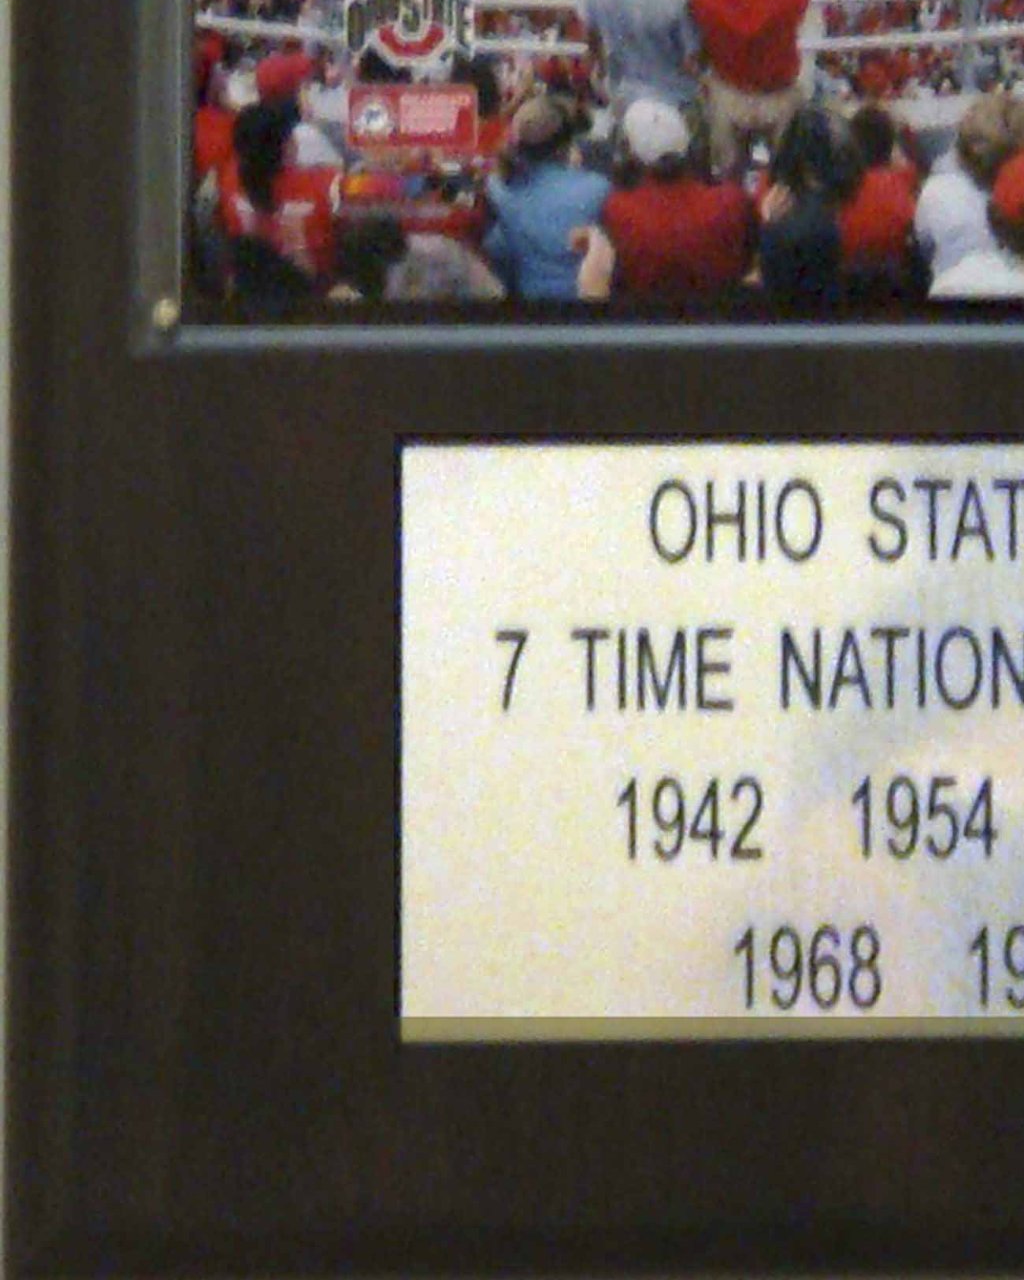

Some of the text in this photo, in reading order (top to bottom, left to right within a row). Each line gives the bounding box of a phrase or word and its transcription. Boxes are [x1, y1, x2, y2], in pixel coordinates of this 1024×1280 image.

[649, 477, 823, 564] OHIO
[495, 628, 530, 713] 7
[570, 626, 735, 712] TIME
[617, 775, 764, 861] 1942
[851, 775, 997, 860] 1954
[733, 924, 882, 1010] 1968
